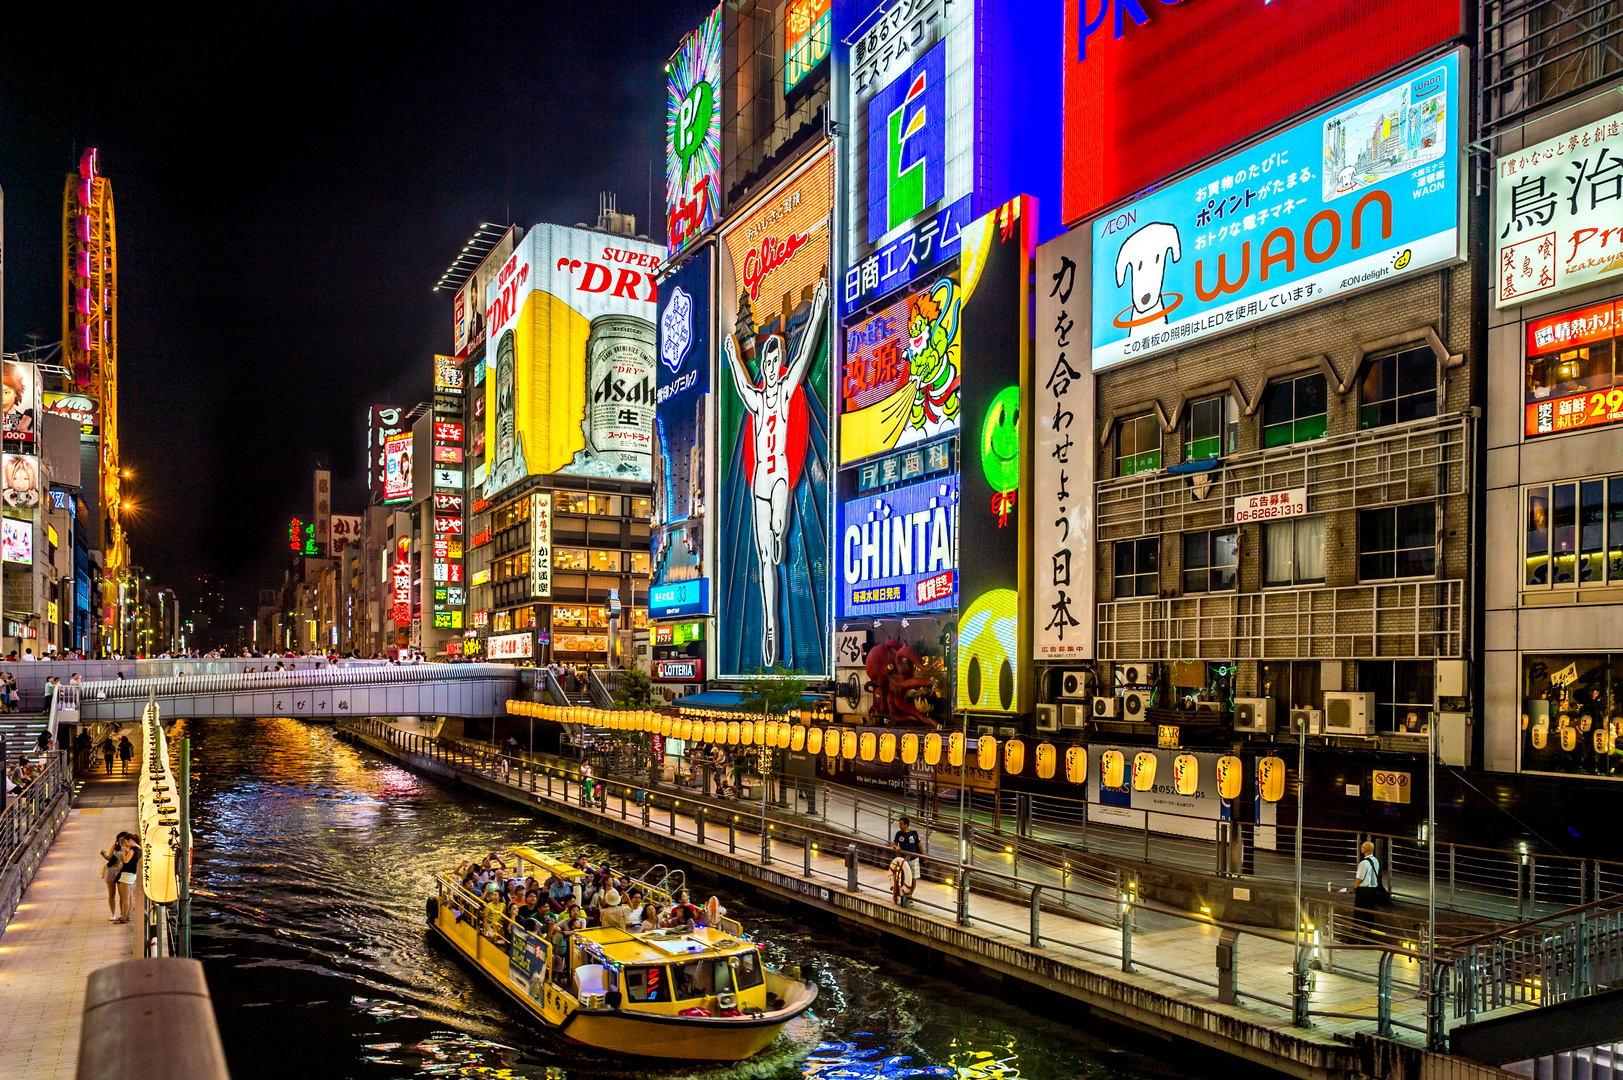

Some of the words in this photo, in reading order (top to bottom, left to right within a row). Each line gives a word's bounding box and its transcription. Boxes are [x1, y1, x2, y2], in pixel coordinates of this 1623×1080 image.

[1195, 150, 1290, 203] お買物のたびに
[1411, 161, 1445, 180] 大阪ミナミ
[1417, 169, 1445, 189] 道頓堀
[1412, 181, 1445, 199] WAON
[1501, 148, 1623, 240] 鳥治
[670, 175, 710, 246] ピップ
[1195, 197, 1308, 251] おトクな電子マネー
[602, 247, 662, 269] SUPER
[845, 209, 963, 304] 日商エステム
[743, 234, 809, 302] Glico
[1361, 266, 1389, 283] delight
[1123, 282, 1323, 356] この看板の照明はLEDを使用しています。
[847, 316, 895, 354] かぜに
[843, 339, 899, 399] 改源
[657, 370, 698, 404] 雪印メグミルク
[1558, 396, 1587, 416] 新鮮
[618, 409, 639, 426] 生
[1557, 412, 1588, 429] ホルモン
[608, 431, 650, 442] スーパードライ
[766, 409, 777, 475] グリコ
[1045, 255, 1082, 642] 力を合わせよう日本
[862, 443, 944, 487] 戸堂歯科
[1249, 492, 1290, 508] 広告募集
[1236, 503, 1304, 522] 06-6262-1313
[852, 586, 901, 604] 毎週水曜日発売
[917, 577, 937, 604] 賃貸
[1041, 645, 1084, 653] 広告募集中
[664, 664, 693, 676] LOTTERIA
[276, 700, 349, 711] えびす橋
[1158, 726, 1179, 738] BAR
